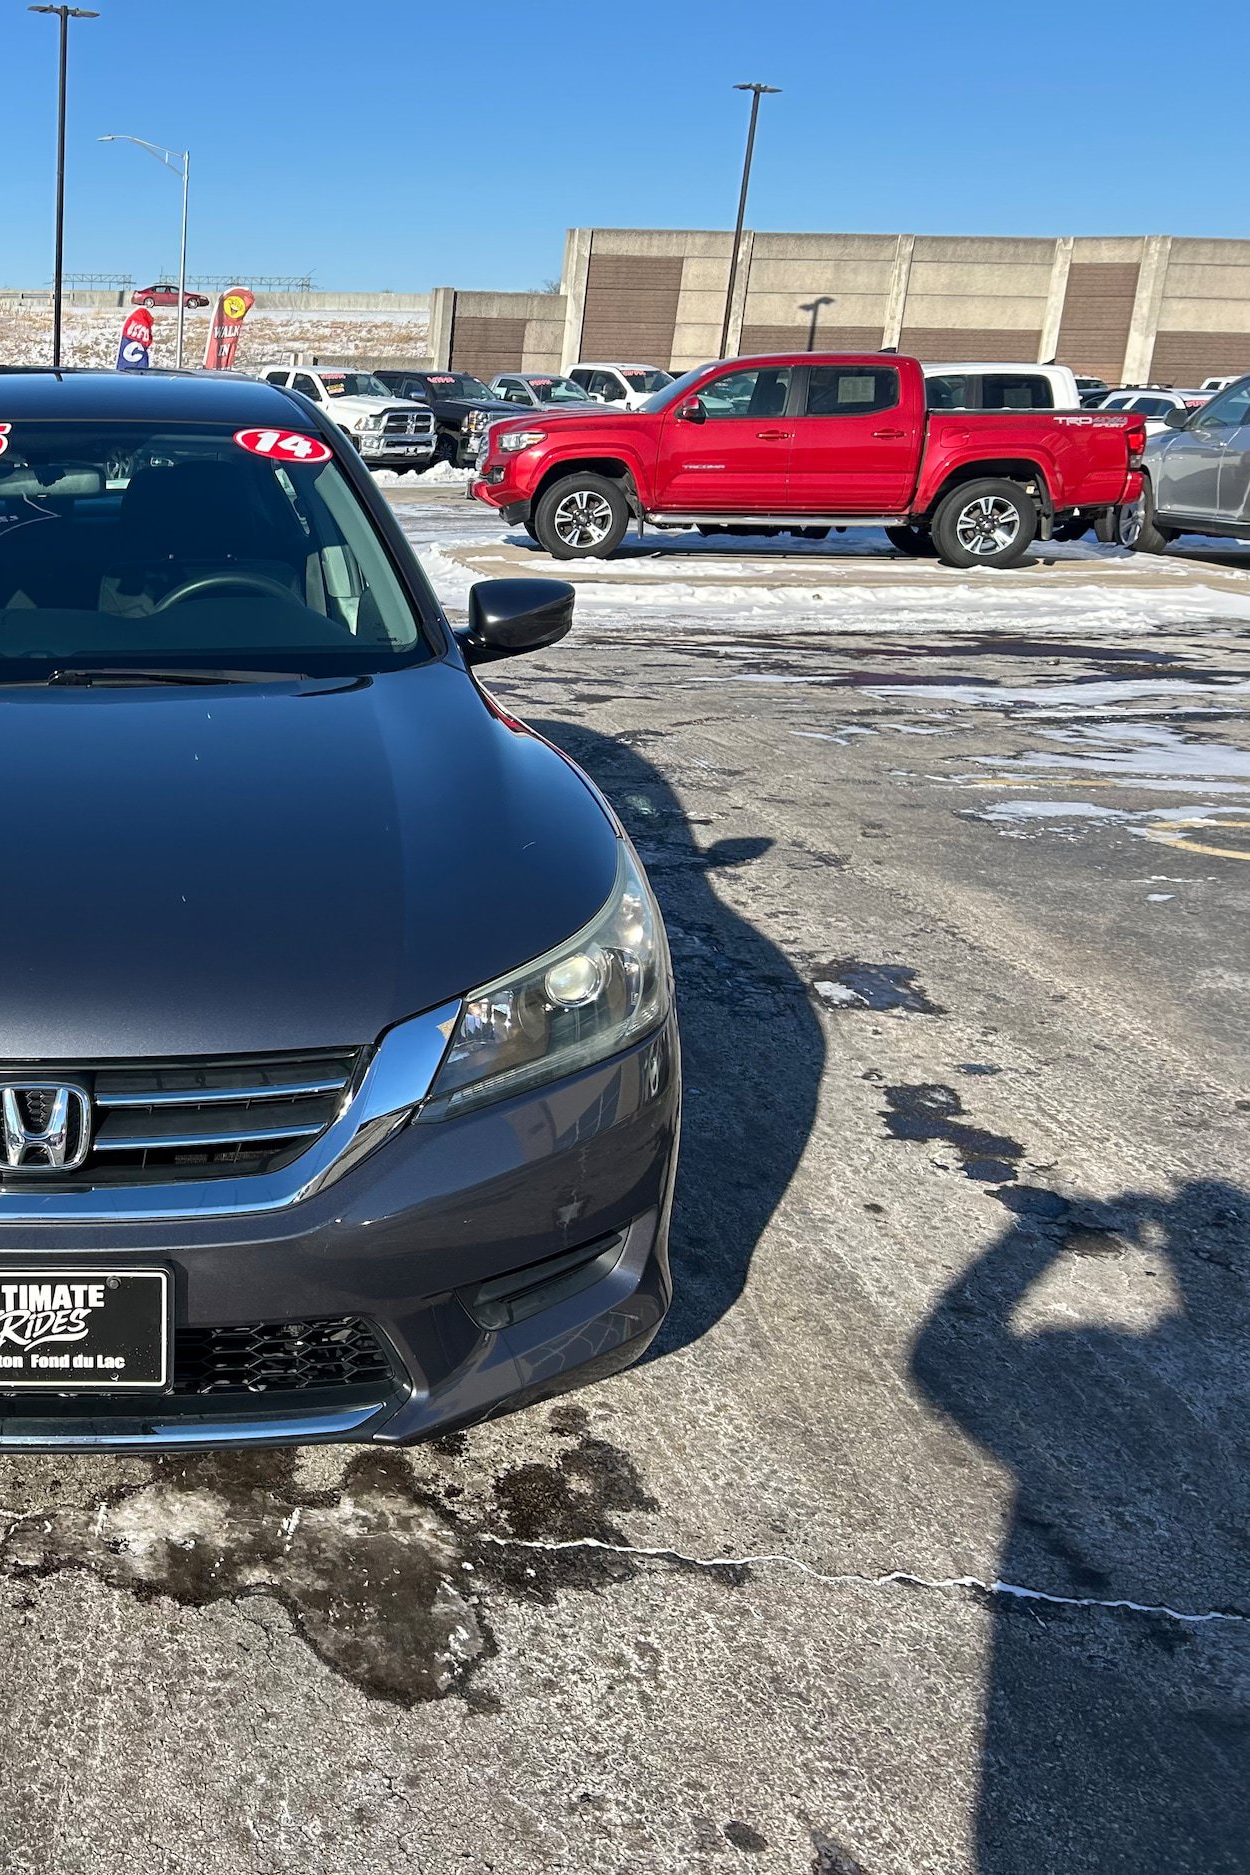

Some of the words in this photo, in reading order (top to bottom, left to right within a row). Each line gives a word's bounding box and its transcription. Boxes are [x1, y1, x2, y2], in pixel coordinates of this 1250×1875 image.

[126, 320, 150, 342] USED
[214, 325, 241, 339] WALK
[218, 343, 230, 357] IN
[1053, 416, 1093, 427] TRD
[254, 431, 314, 459] 14
[30, 1353, 70, 1369] Fond
[72, 1353, 94, 1369] du
[96, 1353, 126, 1369] Lac
